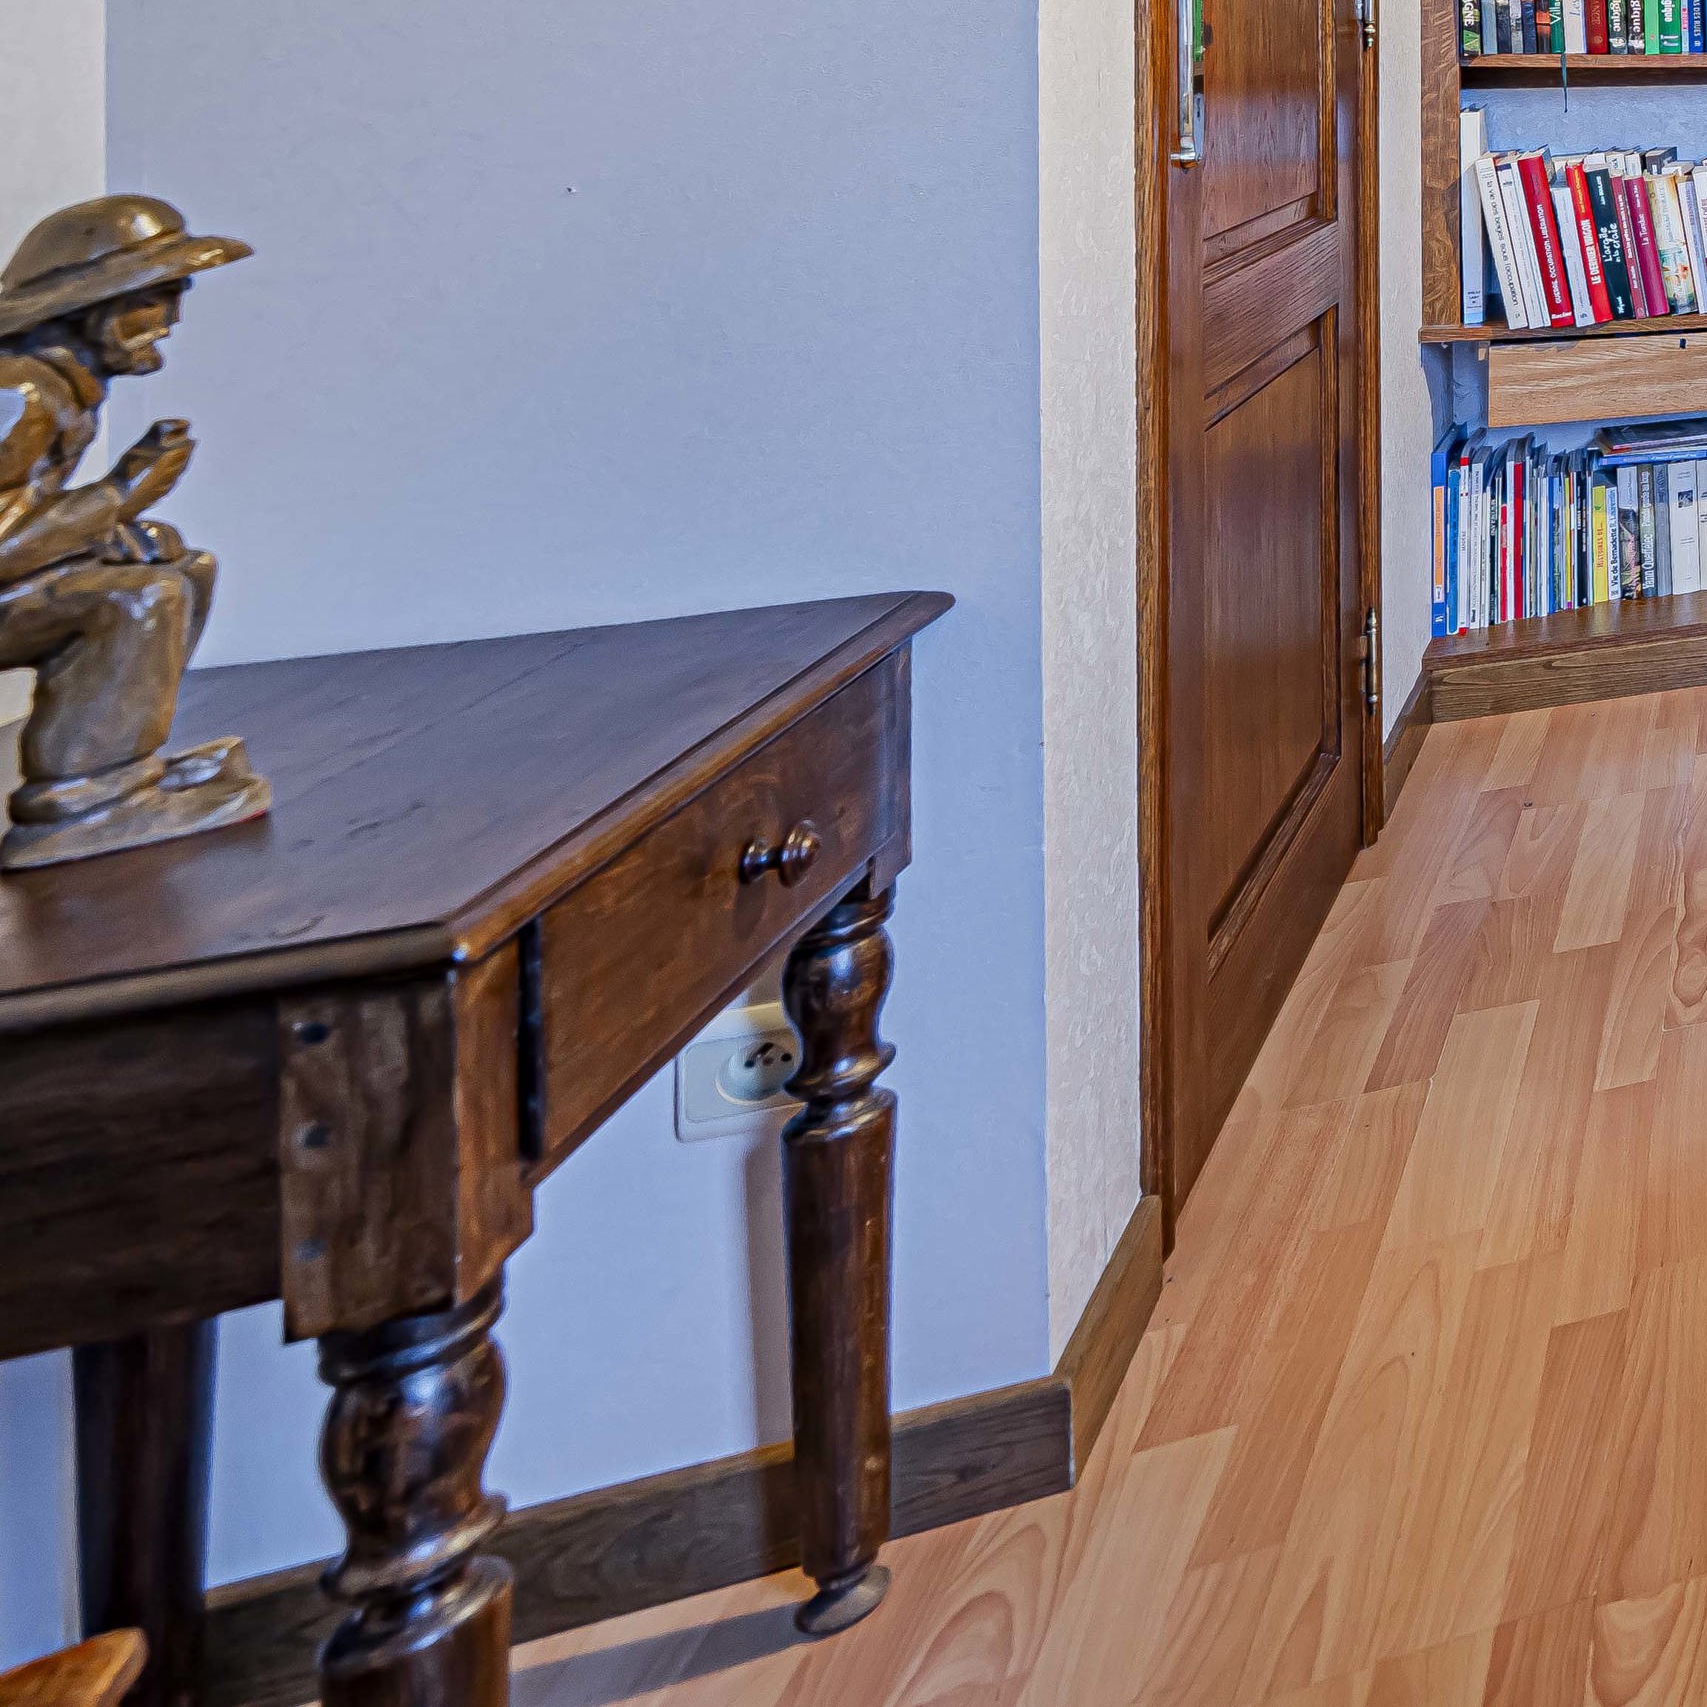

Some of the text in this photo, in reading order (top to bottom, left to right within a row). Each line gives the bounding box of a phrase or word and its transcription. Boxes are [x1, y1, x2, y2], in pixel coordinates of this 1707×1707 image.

[1580, 219, 1601, 284] LE DERNIER WAGON
[1609, 528, 1617, 563] Bernadette
